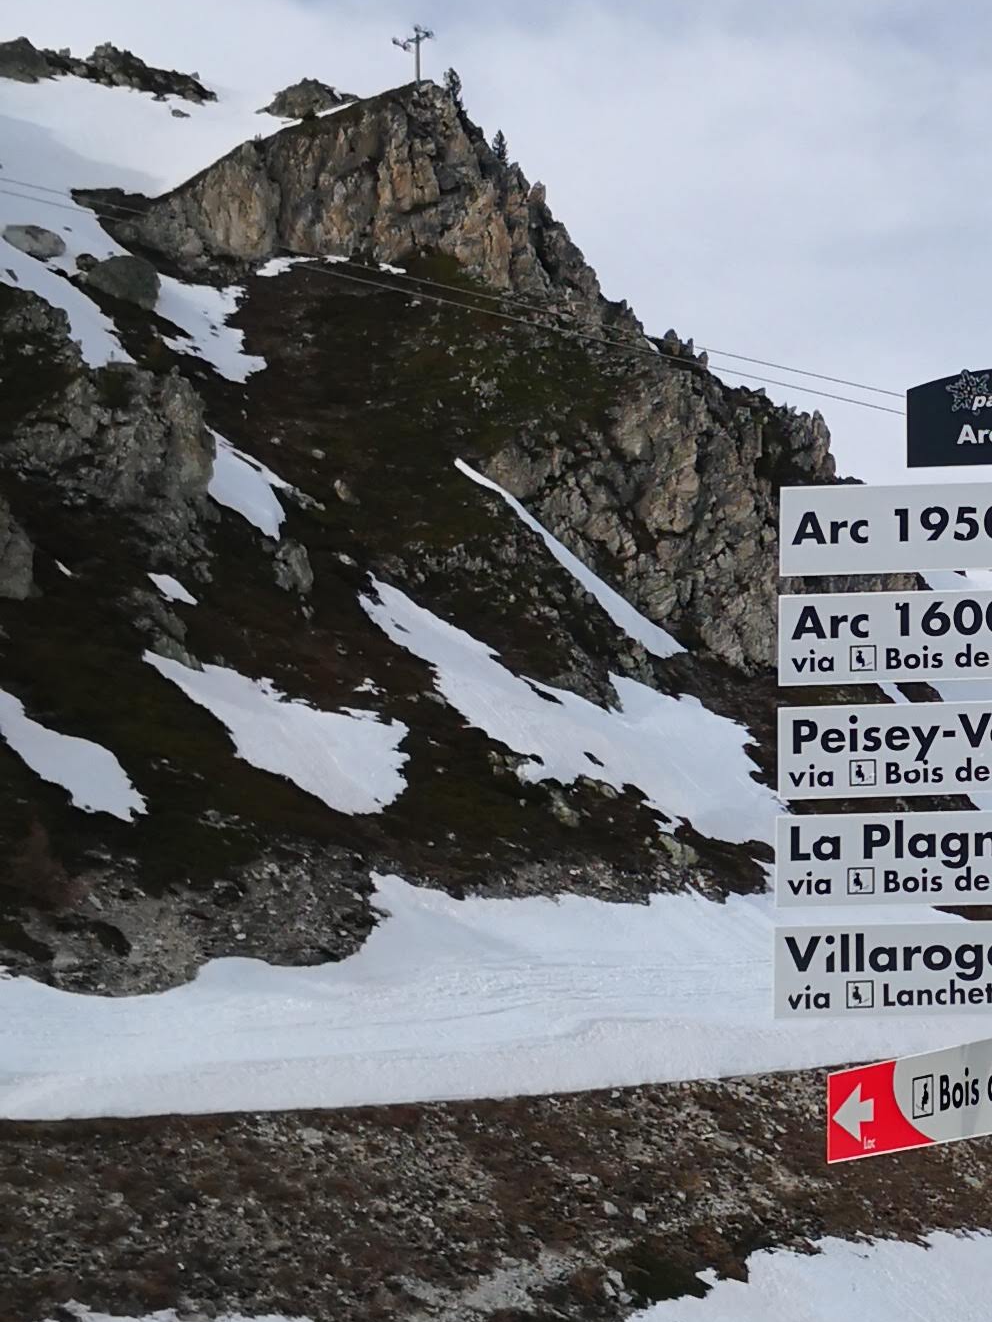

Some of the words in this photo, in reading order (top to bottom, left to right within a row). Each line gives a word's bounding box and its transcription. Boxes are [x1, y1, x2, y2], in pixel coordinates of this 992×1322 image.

[791, 511, 870, 546] Arc
[791, 605, 870, 641] Arc
[791, 648, 836, 674] via
[884, 644, 945, 670] Bois
[954, 643, 990, 668] de
[788, 763, 835, 788] via
[884, 760, 945, 784] Bois
[954, 756, 991, 783] de
[789, 825, 842, 863] La
[787, 870, 833, 896] via
[882, 867, 944, 894] Bois
[954, 864, 991, 892] de
[787, 984, 832, 1011] via
[938, 1067, 981, 1112] Bois
